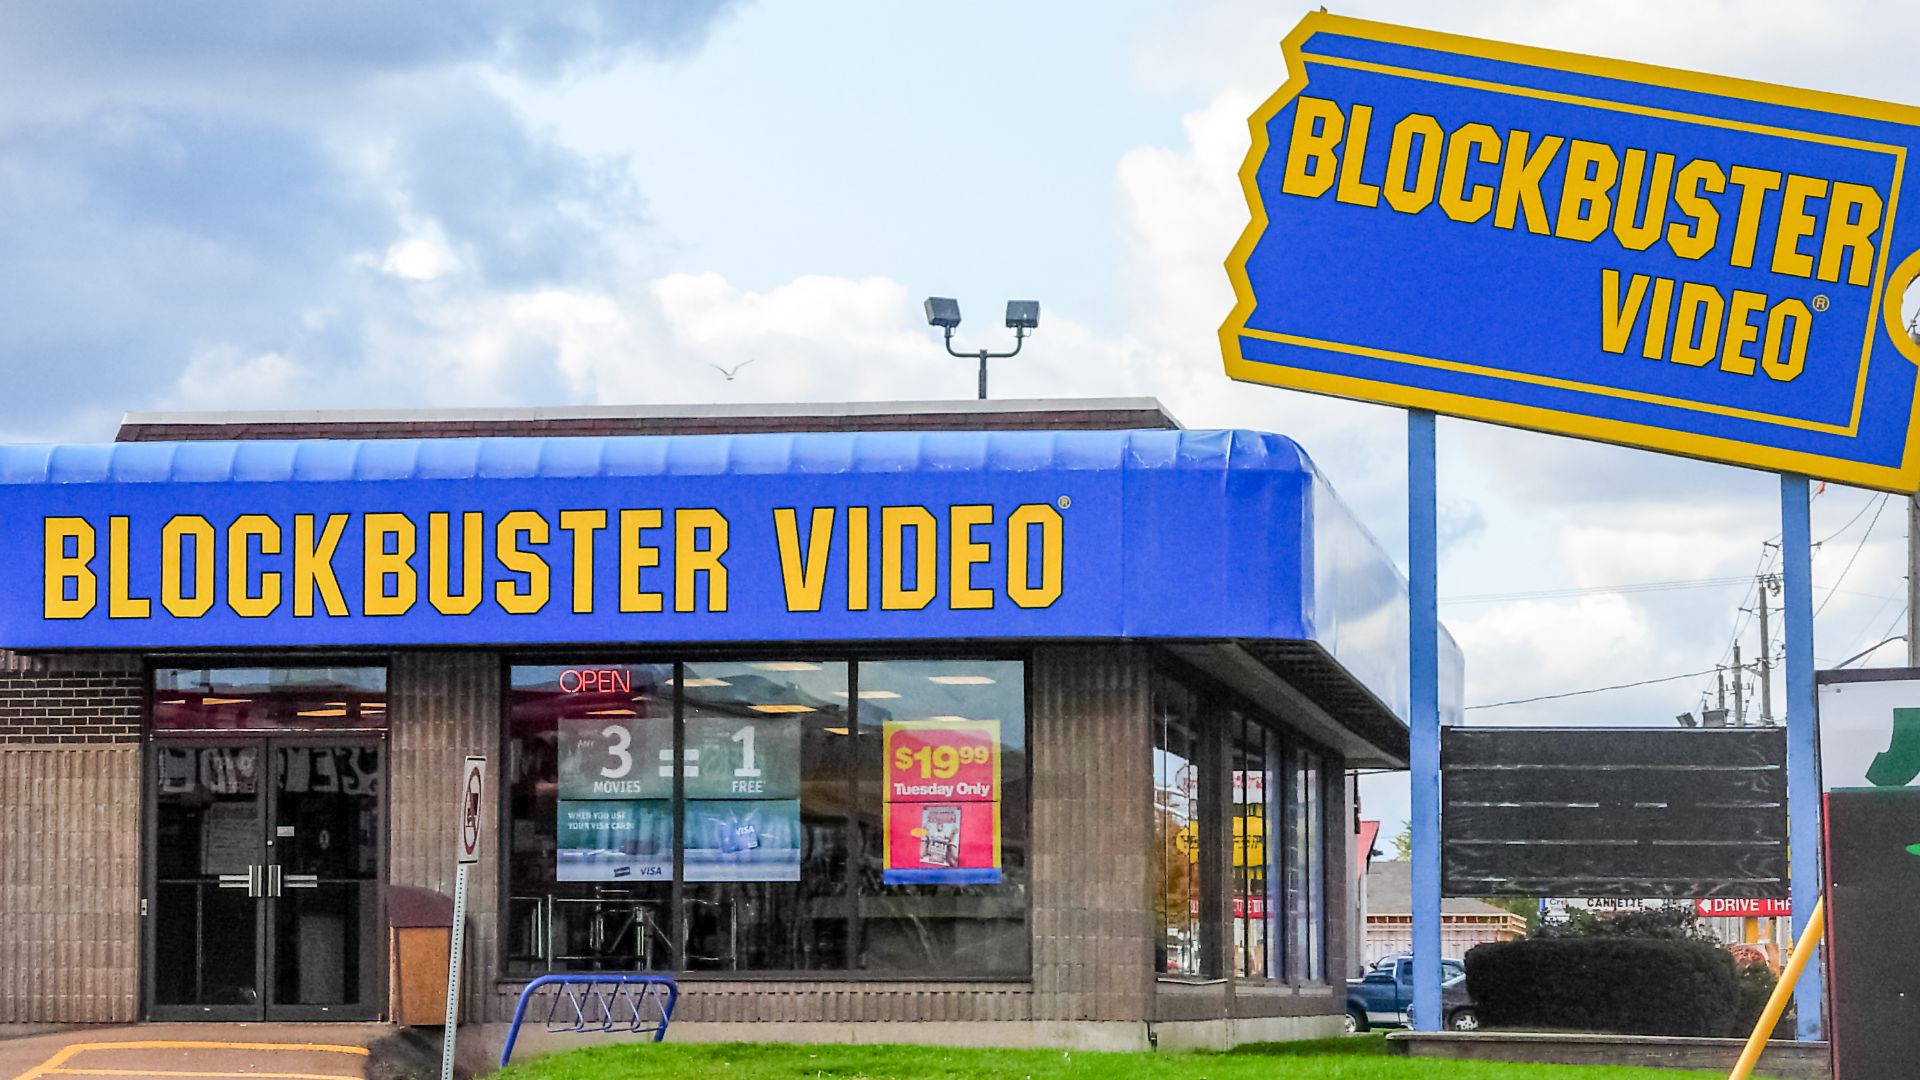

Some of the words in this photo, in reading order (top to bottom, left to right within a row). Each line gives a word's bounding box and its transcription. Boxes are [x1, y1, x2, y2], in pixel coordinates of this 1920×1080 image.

[1282, 95, 1883, 287] BLOCKBUSTER
[44, 507, 729, 620] BLOCKBUSTER
[559, 669, 630, 693] OPEN
[600, 724, 633, 779] 3
[731, 725, 761, 777] 1
[593, 780, 641, 793] MOVIES
[894, 782, 954, 797] Tuesday
[956, 782, 990, 797] Only
[736, 825, 755, 836] VISA
[641, 867, 662, 876] VISA
[1714, 898, 1760, 912] DRIVE
